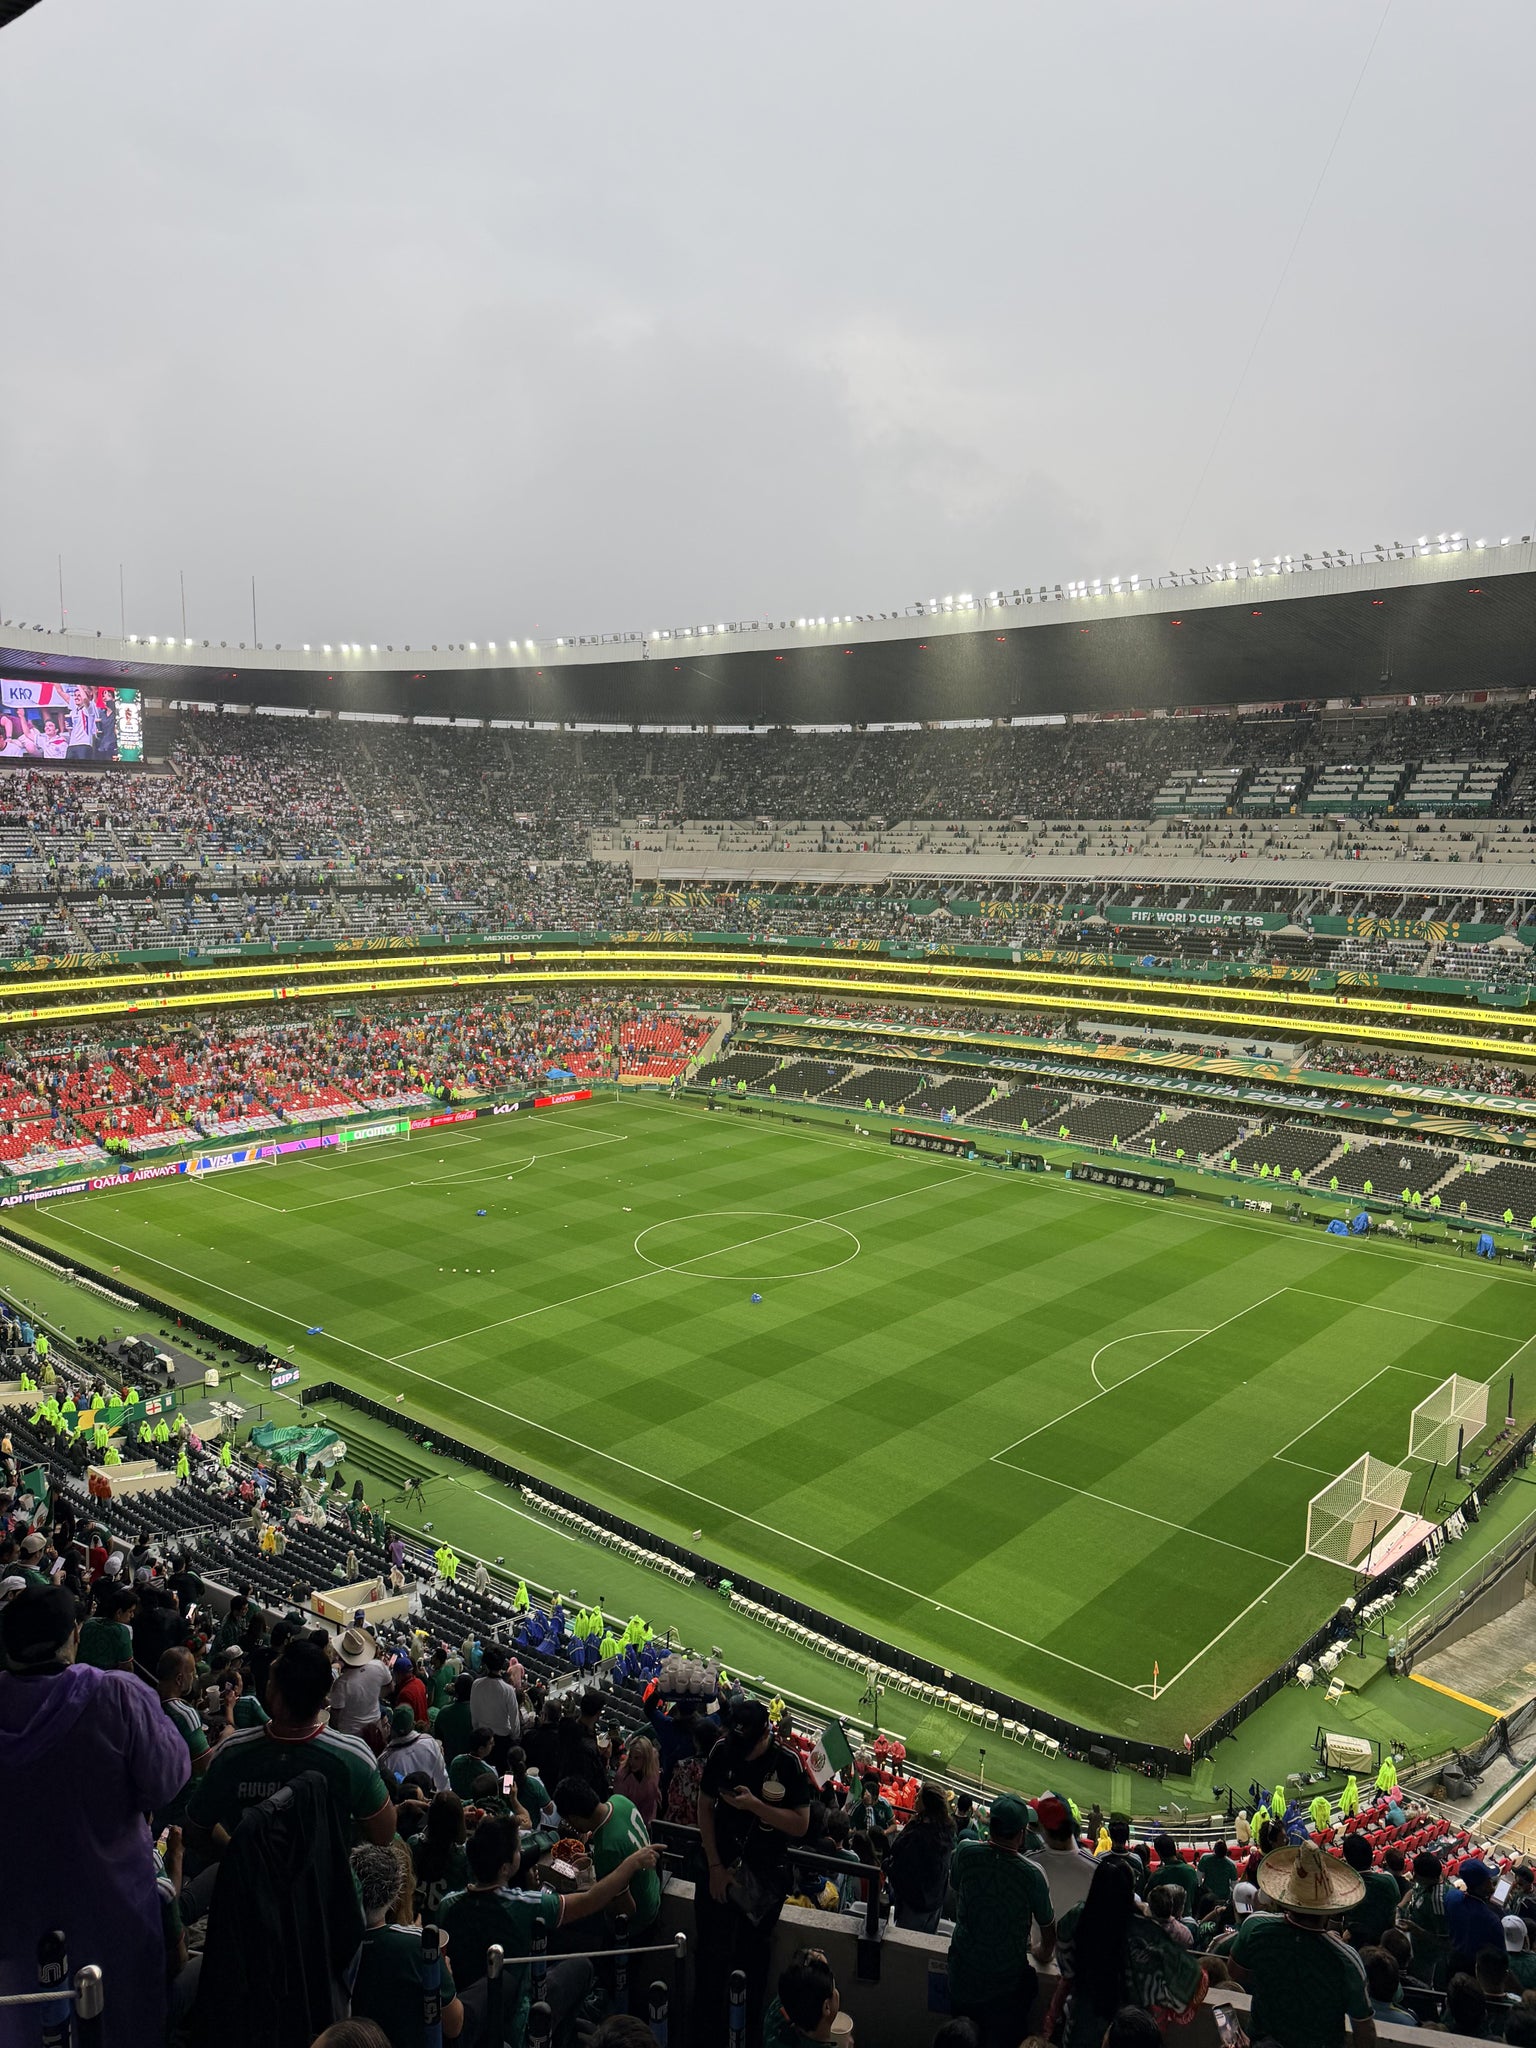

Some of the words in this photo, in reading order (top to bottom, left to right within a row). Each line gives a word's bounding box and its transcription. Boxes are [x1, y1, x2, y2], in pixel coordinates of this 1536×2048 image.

[1198, 914, 1221, 924] CUP
[483, 934, 520, 942] MEXICO
[803, 1017, 907, 1032] MEXICO
[909, 1026, 977, 1038] CITY
[988, 1059, 1038, 1071] COPA
[1039, 1065, 1127, 1082] MUNDIAL
[1130, 1076, 1161, 1086] DE
[1161, 1079, 1186, 1090] LA
[1191, 1084, 1239, 1097] FIFA
[1243, 1092, 1326, 1110] 2026
[551, 1094, 575, 1104] Lenovo
[354, 1124, 397, 1140] aramco
[210, 1154, 234, 1168] VISA
[93, 1175, 130, 1190] QATAR
[133, 1164, 177, 1182] AIRWAYS
[271, 1372, 293, 1387] CUP
